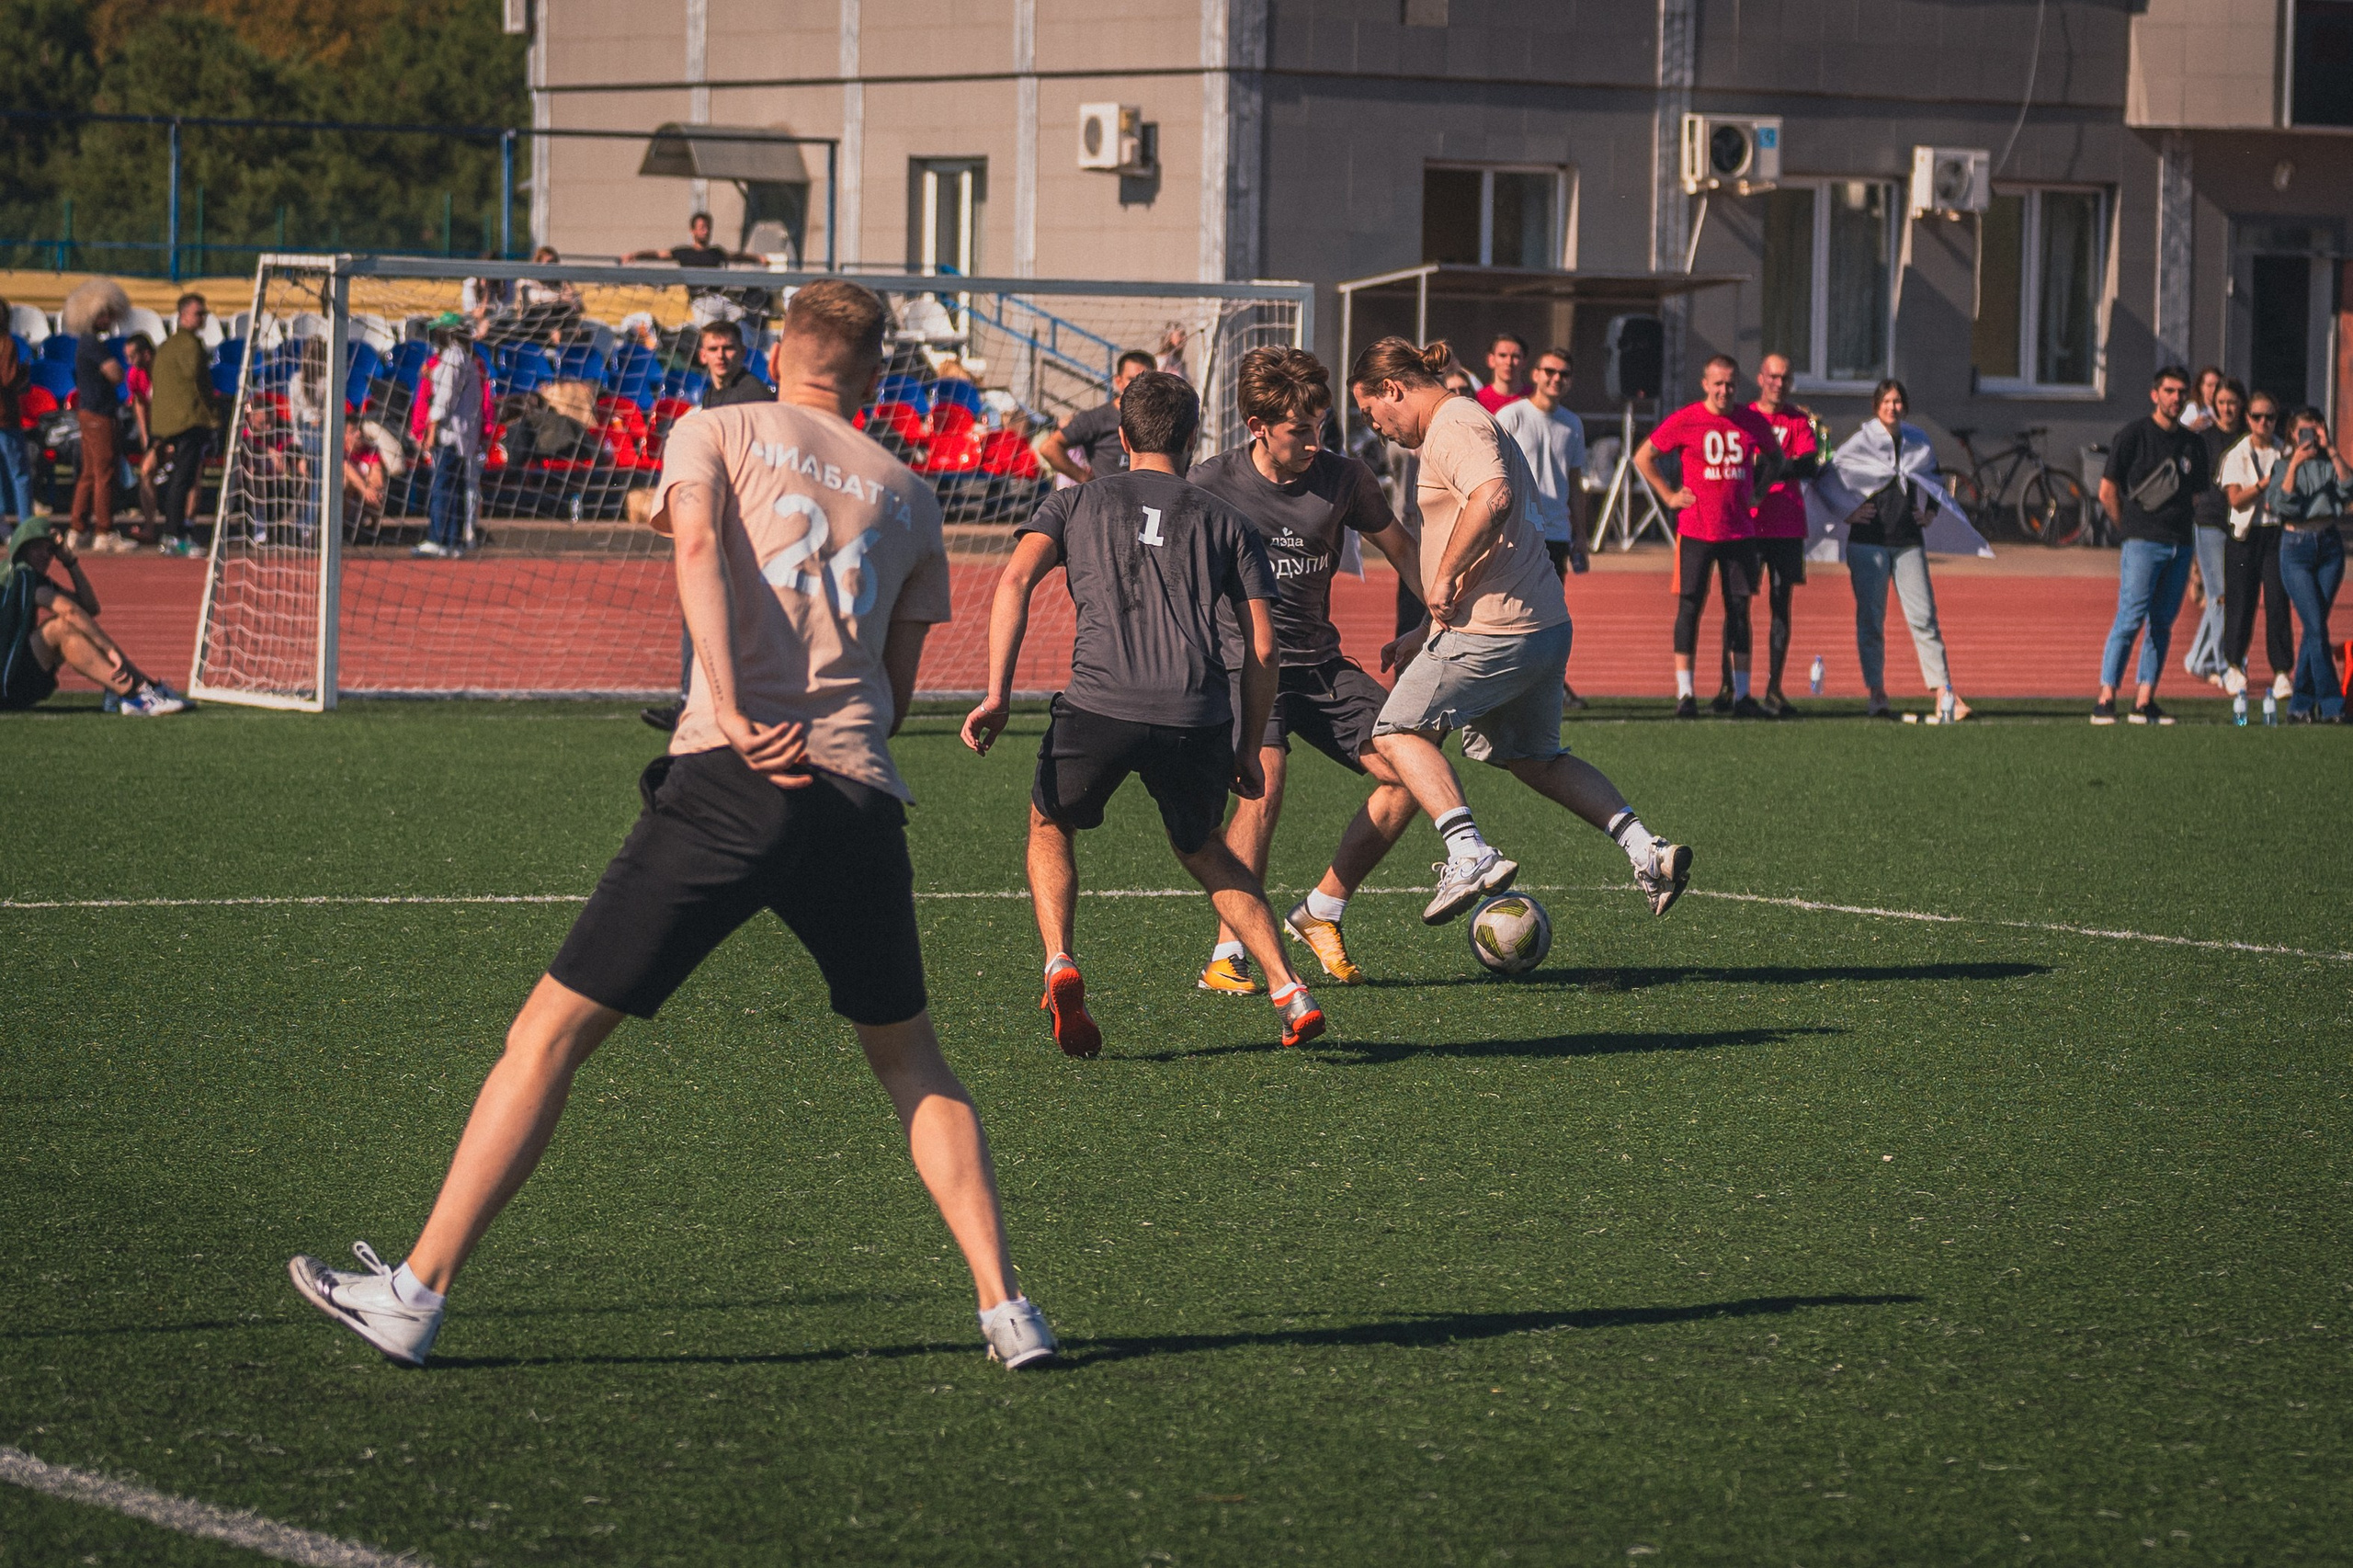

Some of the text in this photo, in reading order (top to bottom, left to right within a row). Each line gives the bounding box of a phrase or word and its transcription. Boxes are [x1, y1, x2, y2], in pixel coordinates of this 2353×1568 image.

[750, 440, 912, 530] ЧИАБАТТА
[760, 493, 882, 617] 26
[1138, 506, 1164, 547] 1
[1270, 537, 1304, 548] дэда
